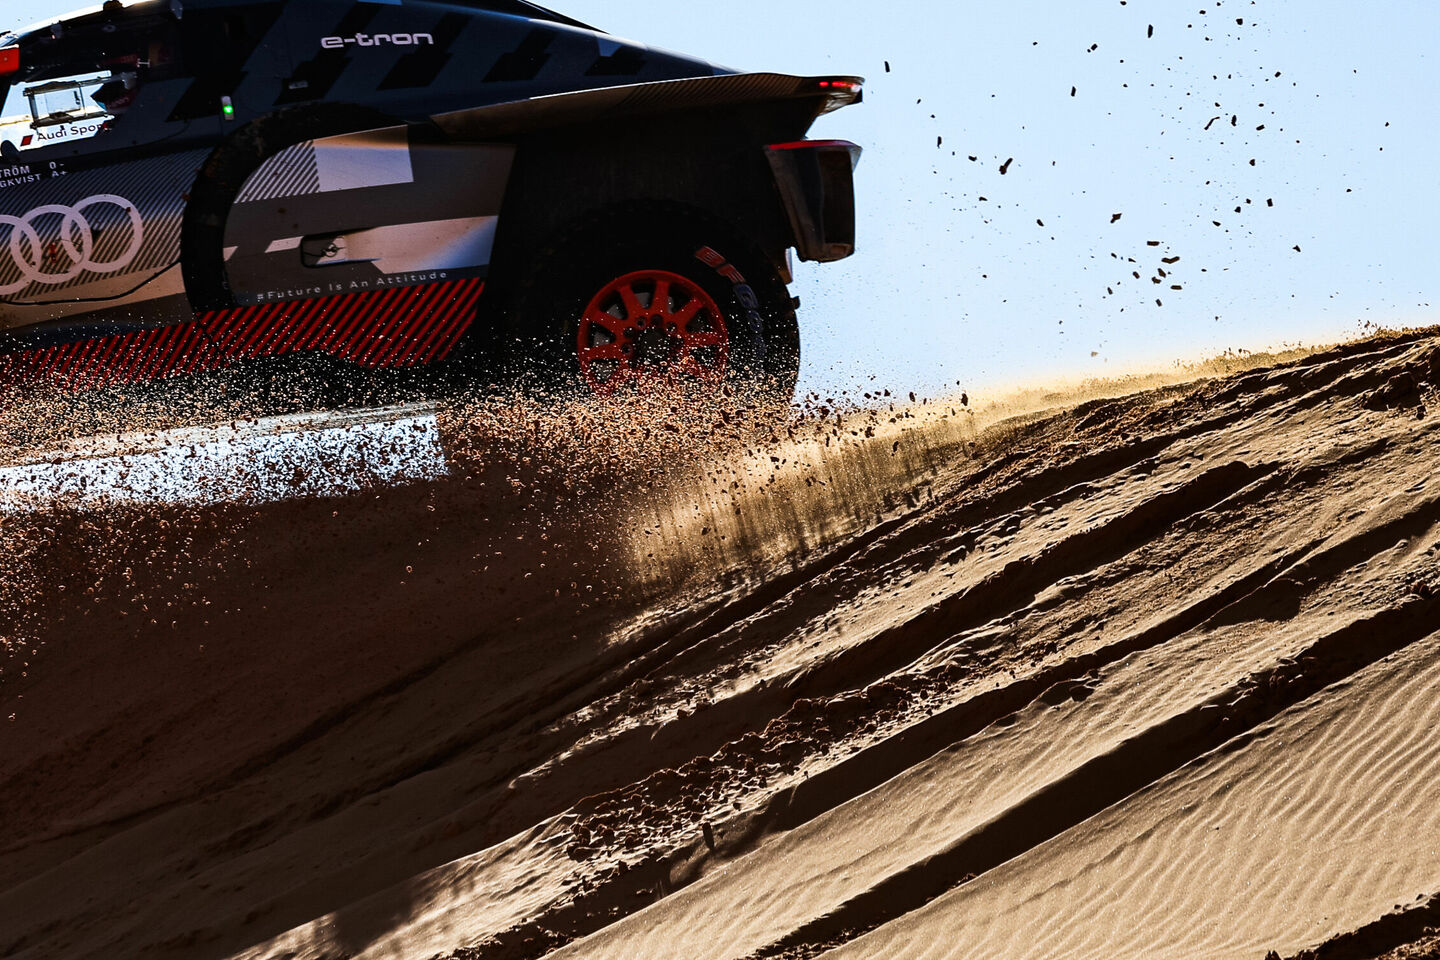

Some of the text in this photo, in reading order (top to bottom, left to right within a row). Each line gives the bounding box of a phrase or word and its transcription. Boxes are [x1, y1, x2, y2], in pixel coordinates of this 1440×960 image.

[321, 32, 435, 49] e-tron
[37, 123, 104, 142] Audi Spor
[257, 271, 447, 301] #Future Is An Attitude
